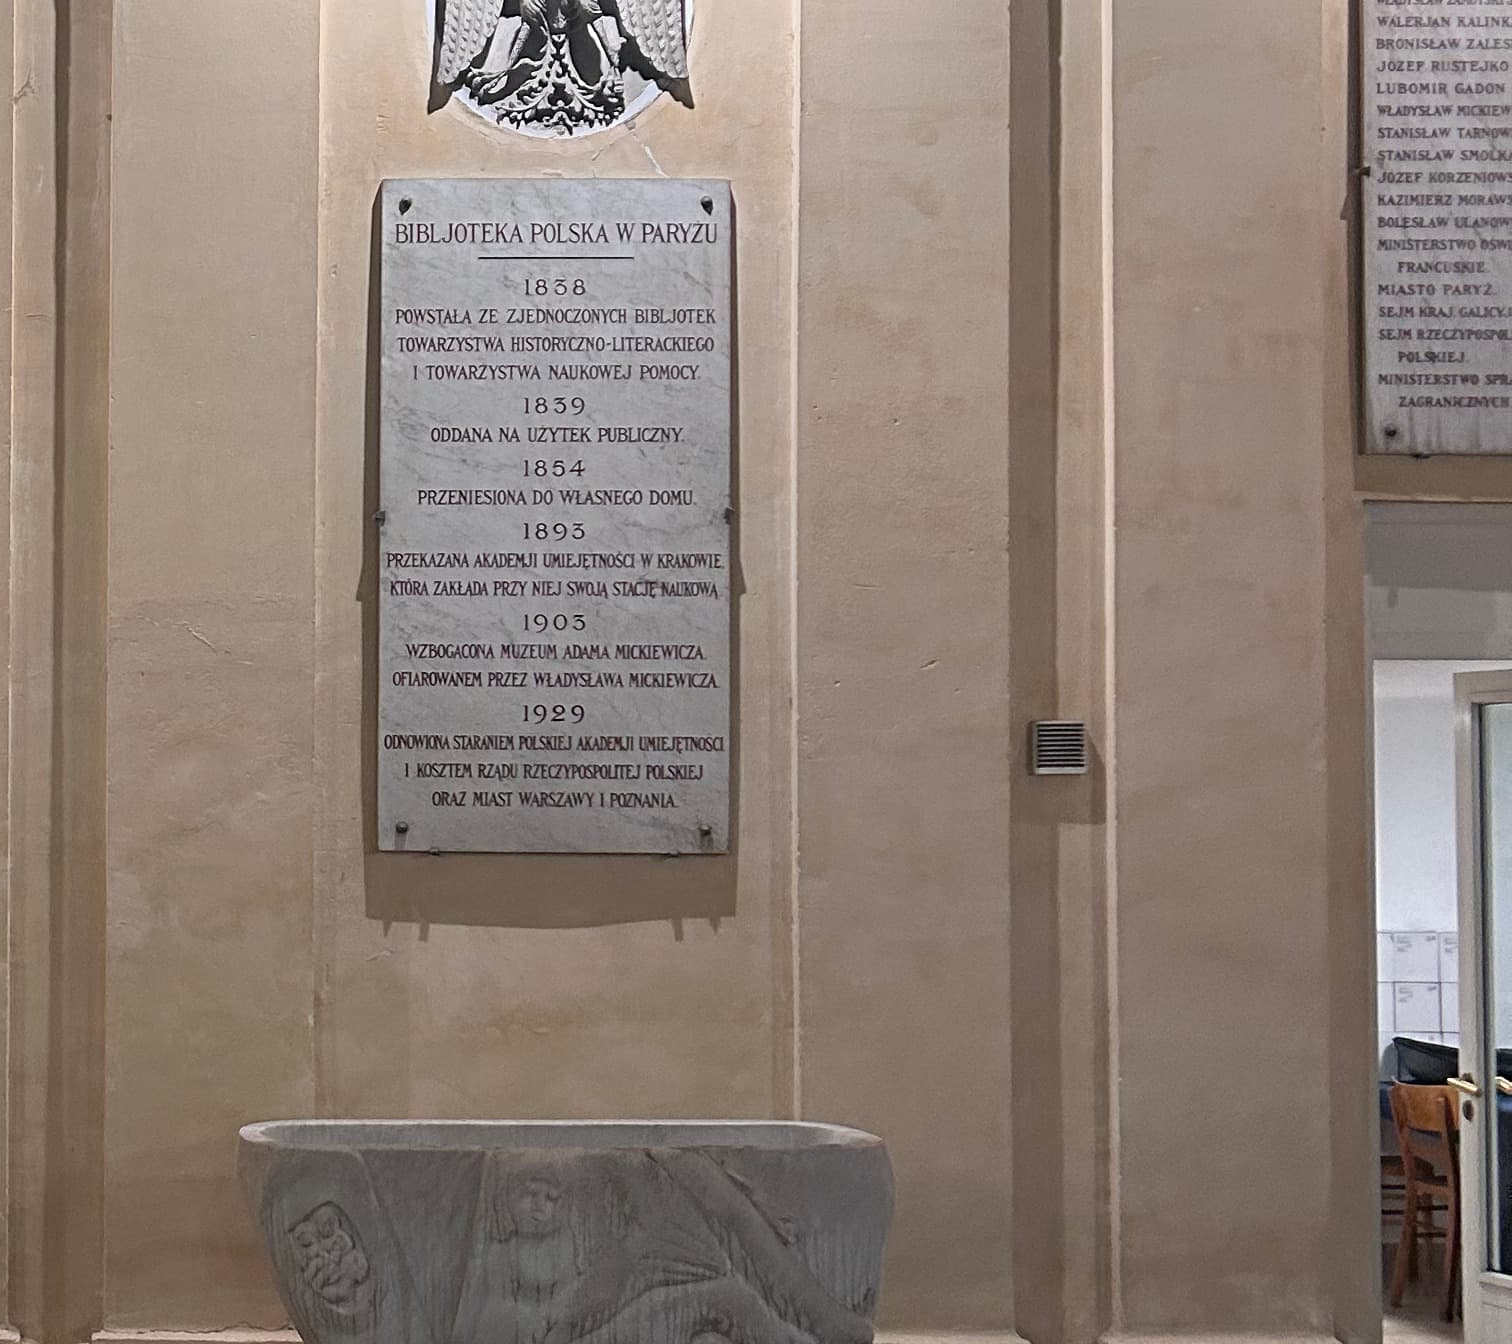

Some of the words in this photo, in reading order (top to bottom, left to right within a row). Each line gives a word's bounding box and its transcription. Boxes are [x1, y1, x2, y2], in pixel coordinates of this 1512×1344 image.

[395, 223, 523, 244] BIBLJOTEKA
[530, 223, 609, 244] POLSKA
[615, 223, 637, 244] W
[524, 278, 587, 297] 1838
[477, 308, 499, 325] ZE
[505, 308, 628, 325] ZJEDNOCZONYCH
[634, 308, 717, 325] BIBLJOTEK
[398, 336, 506, 353] TOWARZYSTWA
[510, 335, 715, 354] HISTORYCZNO-LITERACKIEGO
[425, 364, 542, 381] TOWARZYSTWA
[547, 364, 633, 381] NAUKOWEJ
[523, 396, 586, 416] 1839
[430, 427, 495, 443] ODDANA
[497, 426, 522, 443] NA
[527, 424, 592, 443] UŻYTEK
[523, 459, 587, 478] 1854
[417, 489, 528, 506] PRZENIESIONA
[532, 489, 555, 506] DO
[523, 522, 586, 542] 1893
[386, 552, 470, 569] PRZEKAZANA
[472, 552, 538, 569] AKADEMJI
[542, 551, 636, 570] UMIEJĘTNOŚCI
[640, 552, 654, 568] W
[389, 577, 430, 597] KTÓRA
[492, 580, 530, 597] PRZY
[531, 580, 563, 597] NIEJ
[565, 580, 610, 600] SWOJĄ
[523, 613, 587, 634] 1903
[406, 643, 497, 660] WZBOGACONA
[500, 643, 559, 660] MUZEUM
[562, 643, 610, 660] ADAMA
[392, 671, 483, 688] OFIAROWANEM
[487, 671, 529, 688] PRZEZ
[522, 705, 585, 726] 1929
[383, 734, 451, 750] ODNOWIONA
[452, 734, 516, 751] STARANIEM
[518, 734, 573, 752] POLSKIEJ
[575, 735, 635, 752] AKADEMJI
[416, 762, 474, 779] KOSZTEM
[477, 763, 519, 782] RZĄDU
[522, 762, 642, 781] RZECZYPOSPOLITEJ
[645, 764, 704, 781] POLSKIEJ
[431, 790, 467, 807] ORAZ
[471, 791, 514, 808] MIAST
[517, 791, 596, 808] WARSZAWY
